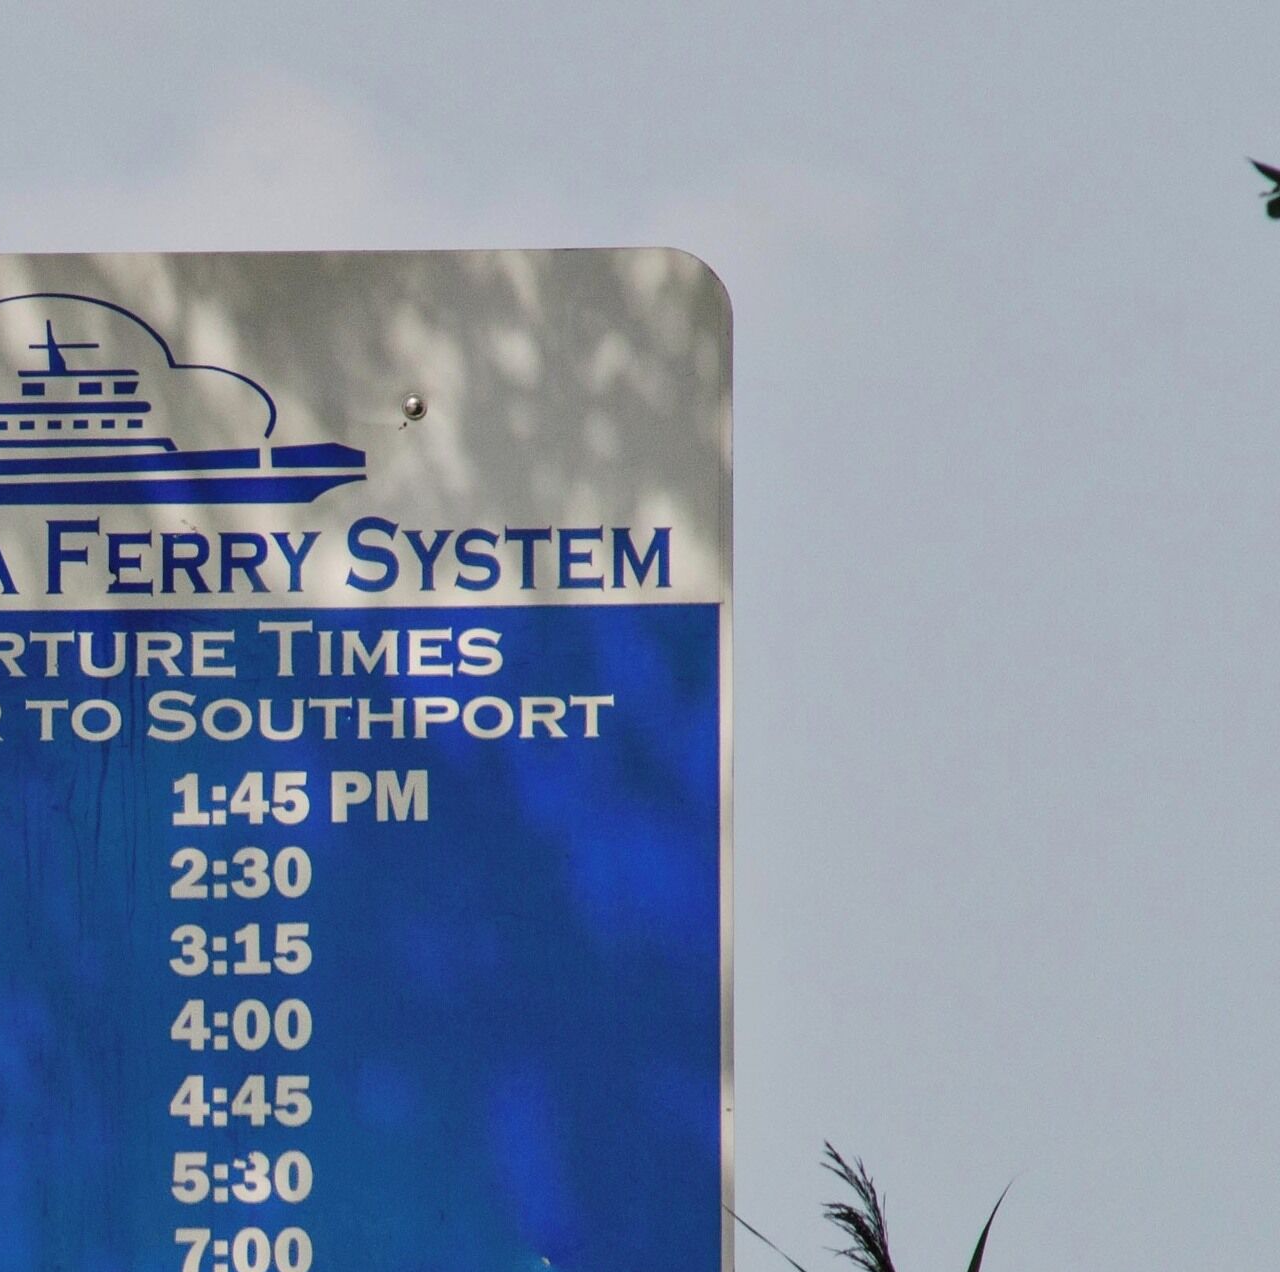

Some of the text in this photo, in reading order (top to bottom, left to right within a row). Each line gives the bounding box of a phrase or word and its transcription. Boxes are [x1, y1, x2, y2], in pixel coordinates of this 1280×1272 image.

[48, 522, 316, 595] FERRY
[347, 517, 669, 593] SYSTEM
[259, 621, 503, 677] TIMES
[26, 700, 122, 742] TO
[147, 690, 615, 742] SOUTHPORT
[172, 770, 428, 825] 1:45 PM
[170, 847, 312, 899] 2:30
[169, 923, 312, 975] 3:15
[171, 999, 312, 1051] 4:00
[170, 1075, 312, 1127] 4:45
[171, 1151, 313, 1204] 5:30
